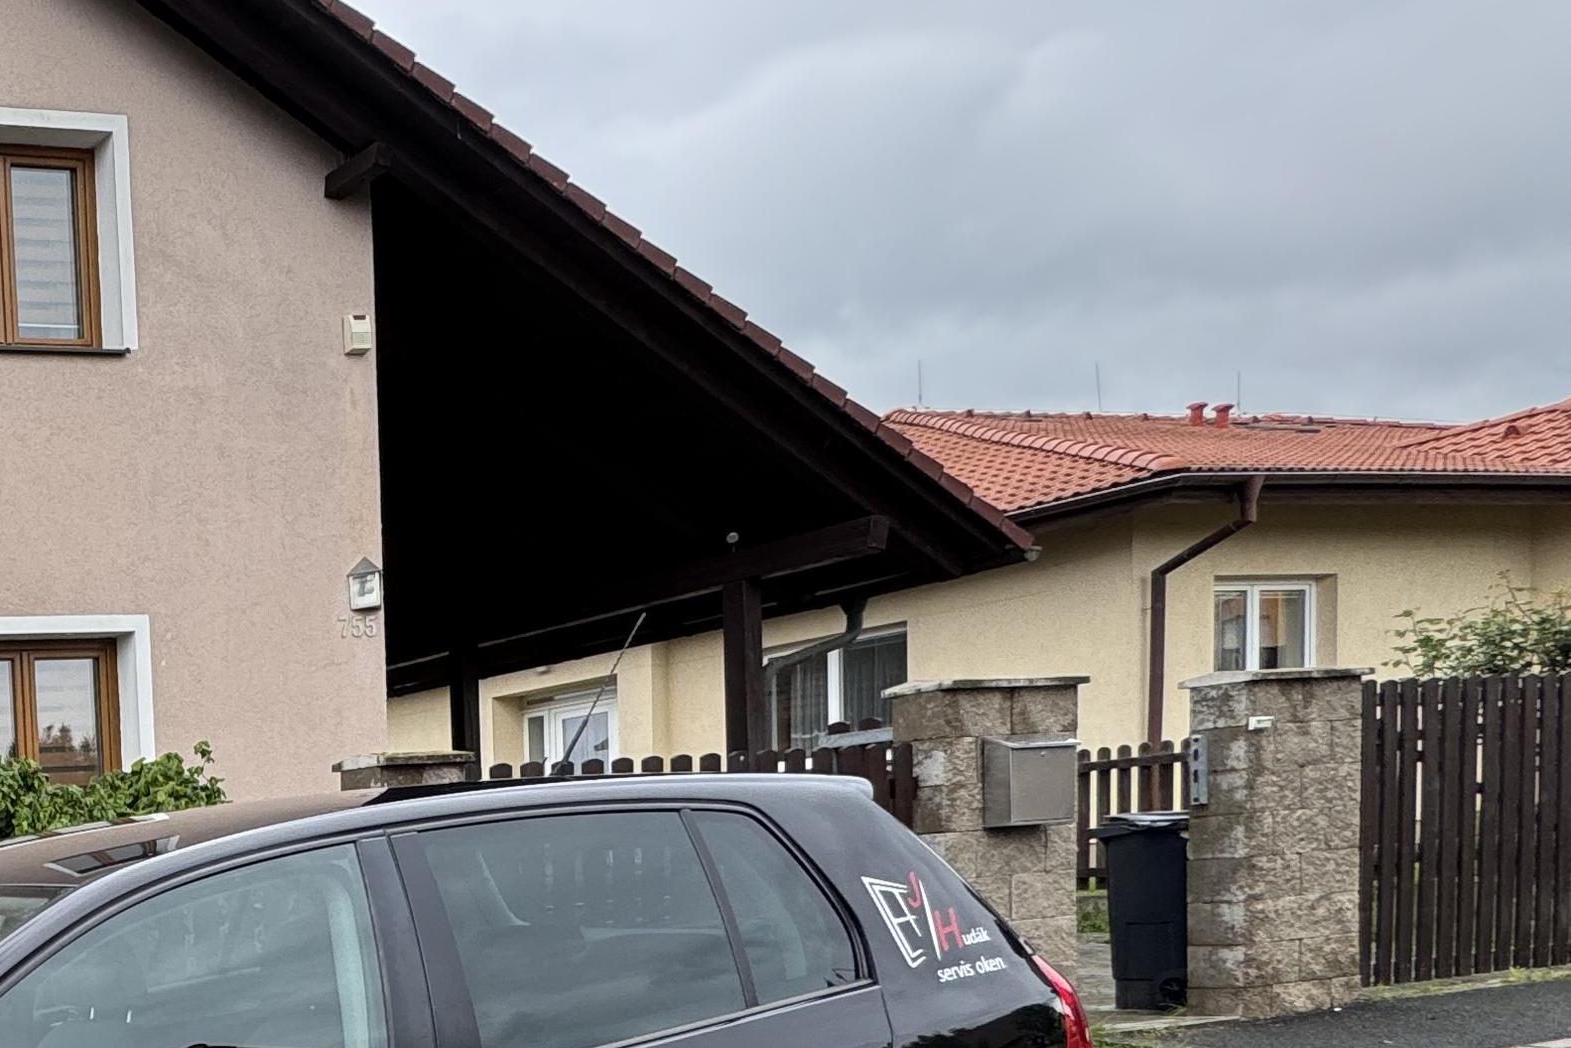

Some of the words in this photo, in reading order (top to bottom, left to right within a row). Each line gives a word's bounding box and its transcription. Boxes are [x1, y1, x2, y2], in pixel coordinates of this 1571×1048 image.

[338, 616, 378, 639] 755
[937, 960, 975, 983] servis
[975, 955, 1006, 974] oken
